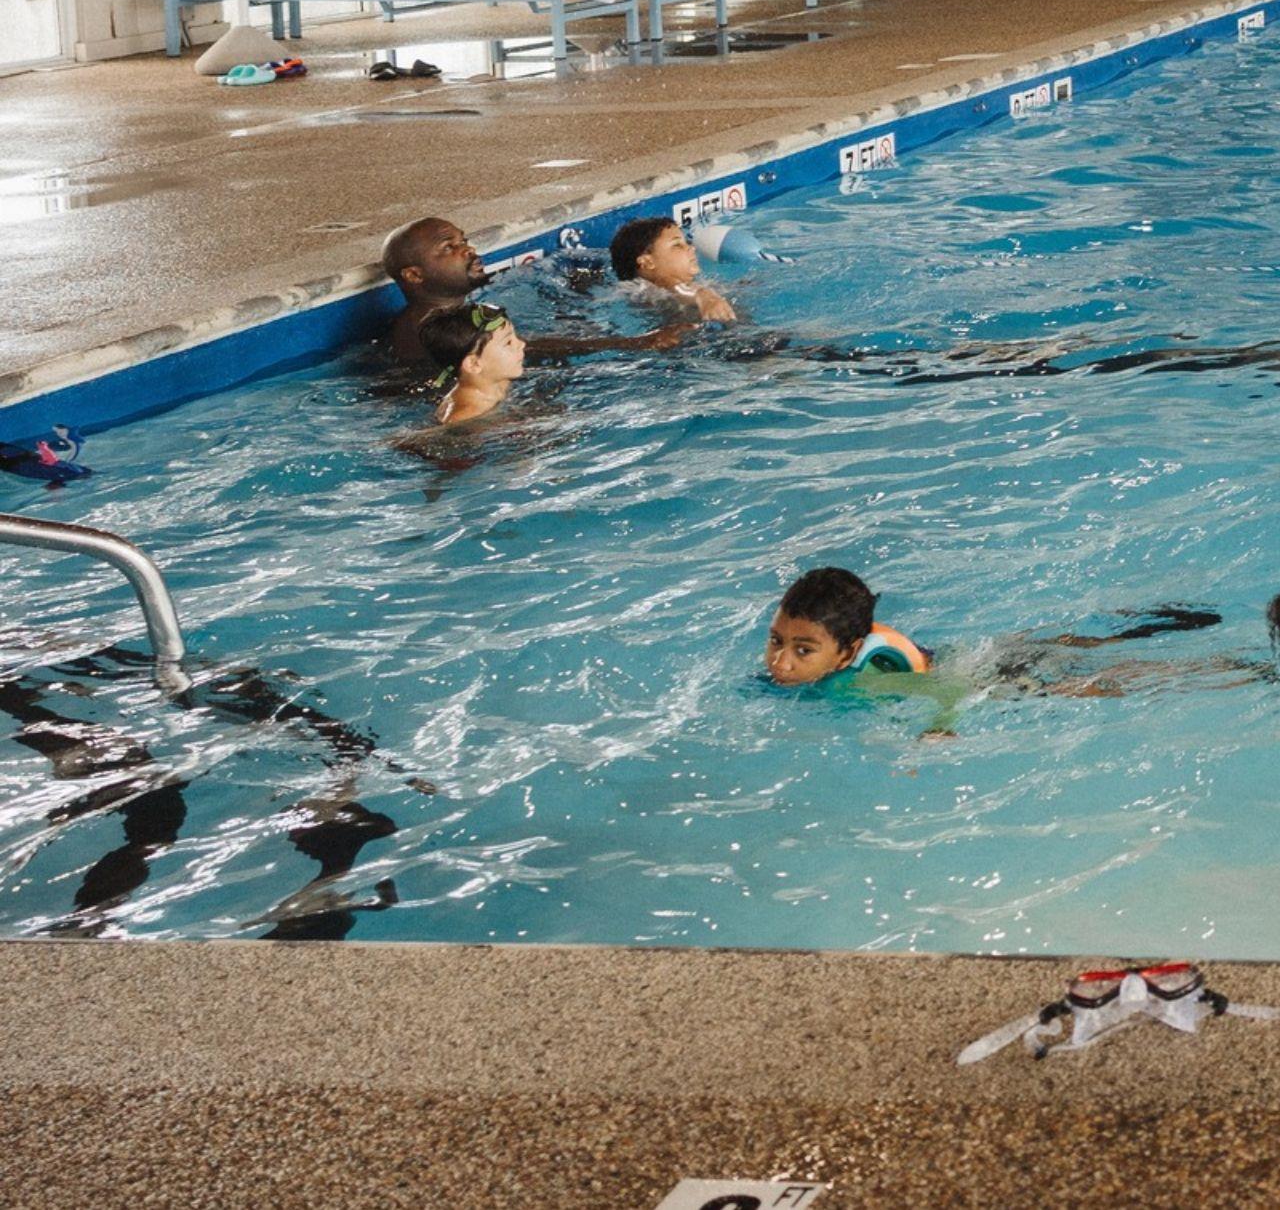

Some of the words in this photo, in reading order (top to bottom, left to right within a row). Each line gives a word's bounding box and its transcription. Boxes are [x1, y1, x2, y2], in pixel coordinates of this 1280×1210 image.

[861, 145, 875, 170] FT
[681, 207, 692, 228] 5
[773, 1186, 815, 1208] FT
